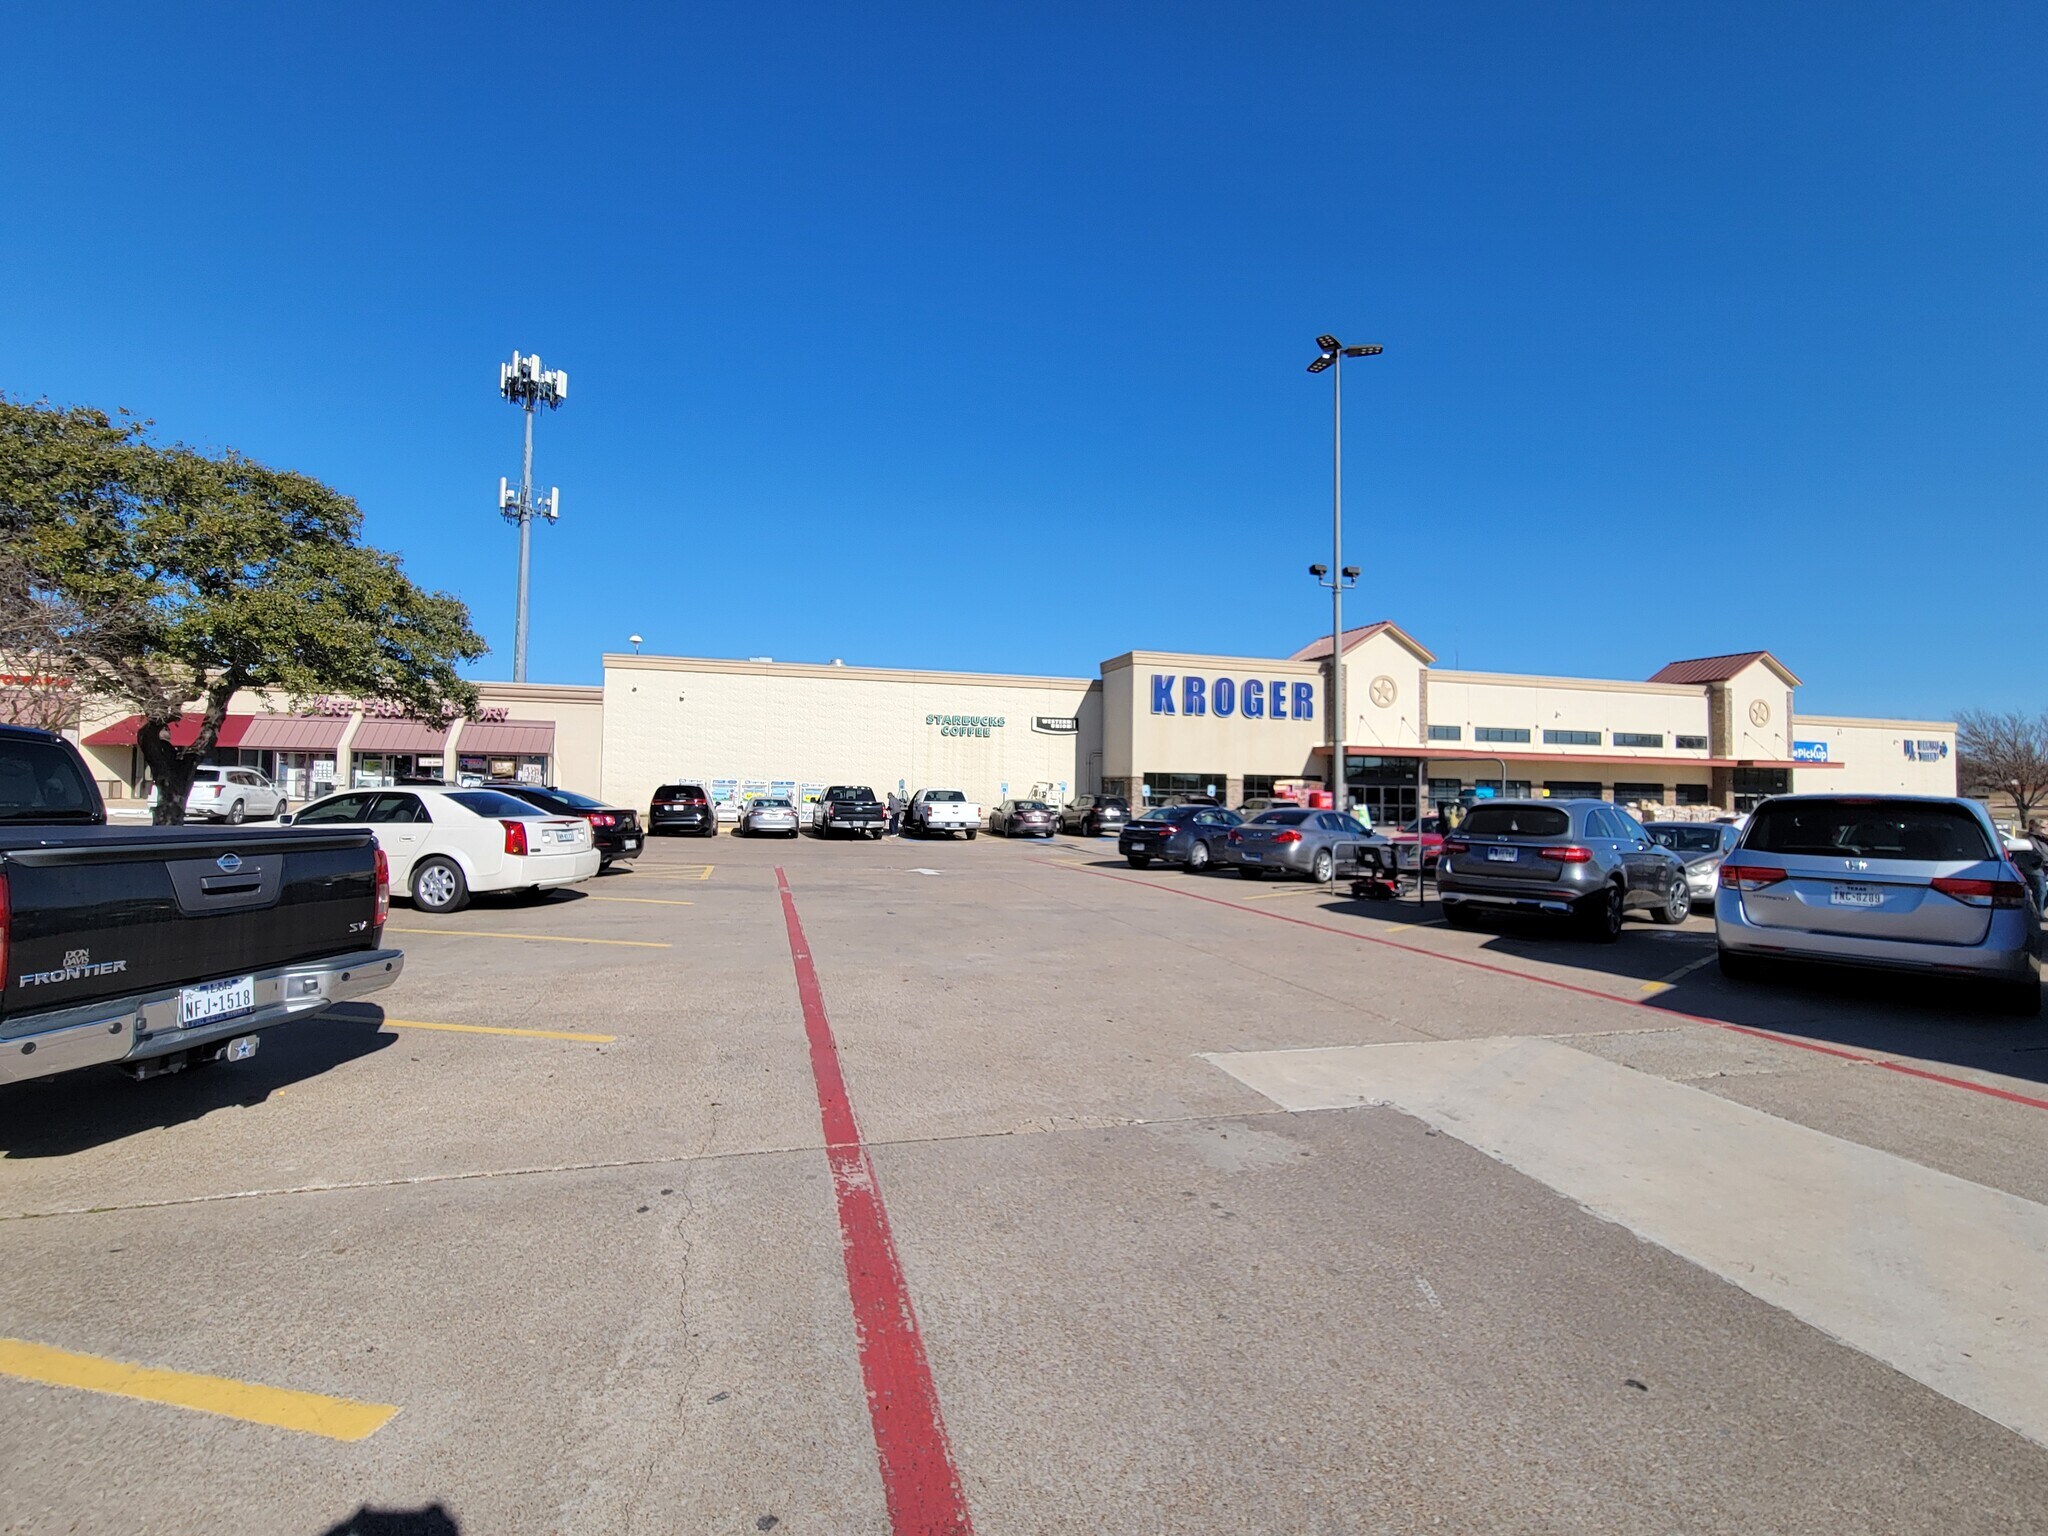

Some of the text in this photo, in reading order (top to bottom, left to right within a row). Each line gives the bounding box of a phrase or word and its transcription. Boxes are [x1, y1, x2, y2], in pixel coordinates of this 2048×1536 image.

[1151, 674, 1314, 721] KROGER
[926, 714, 1006, 727] STARBUCKS
[941, 726, 991, 737] COFFEE
[349, 920, 368, 933] SV
[65, 948, 90, 960] DON
[63, 956, 90, 968] DAVIS
[19, 960, 128, 989] FRONTIER
